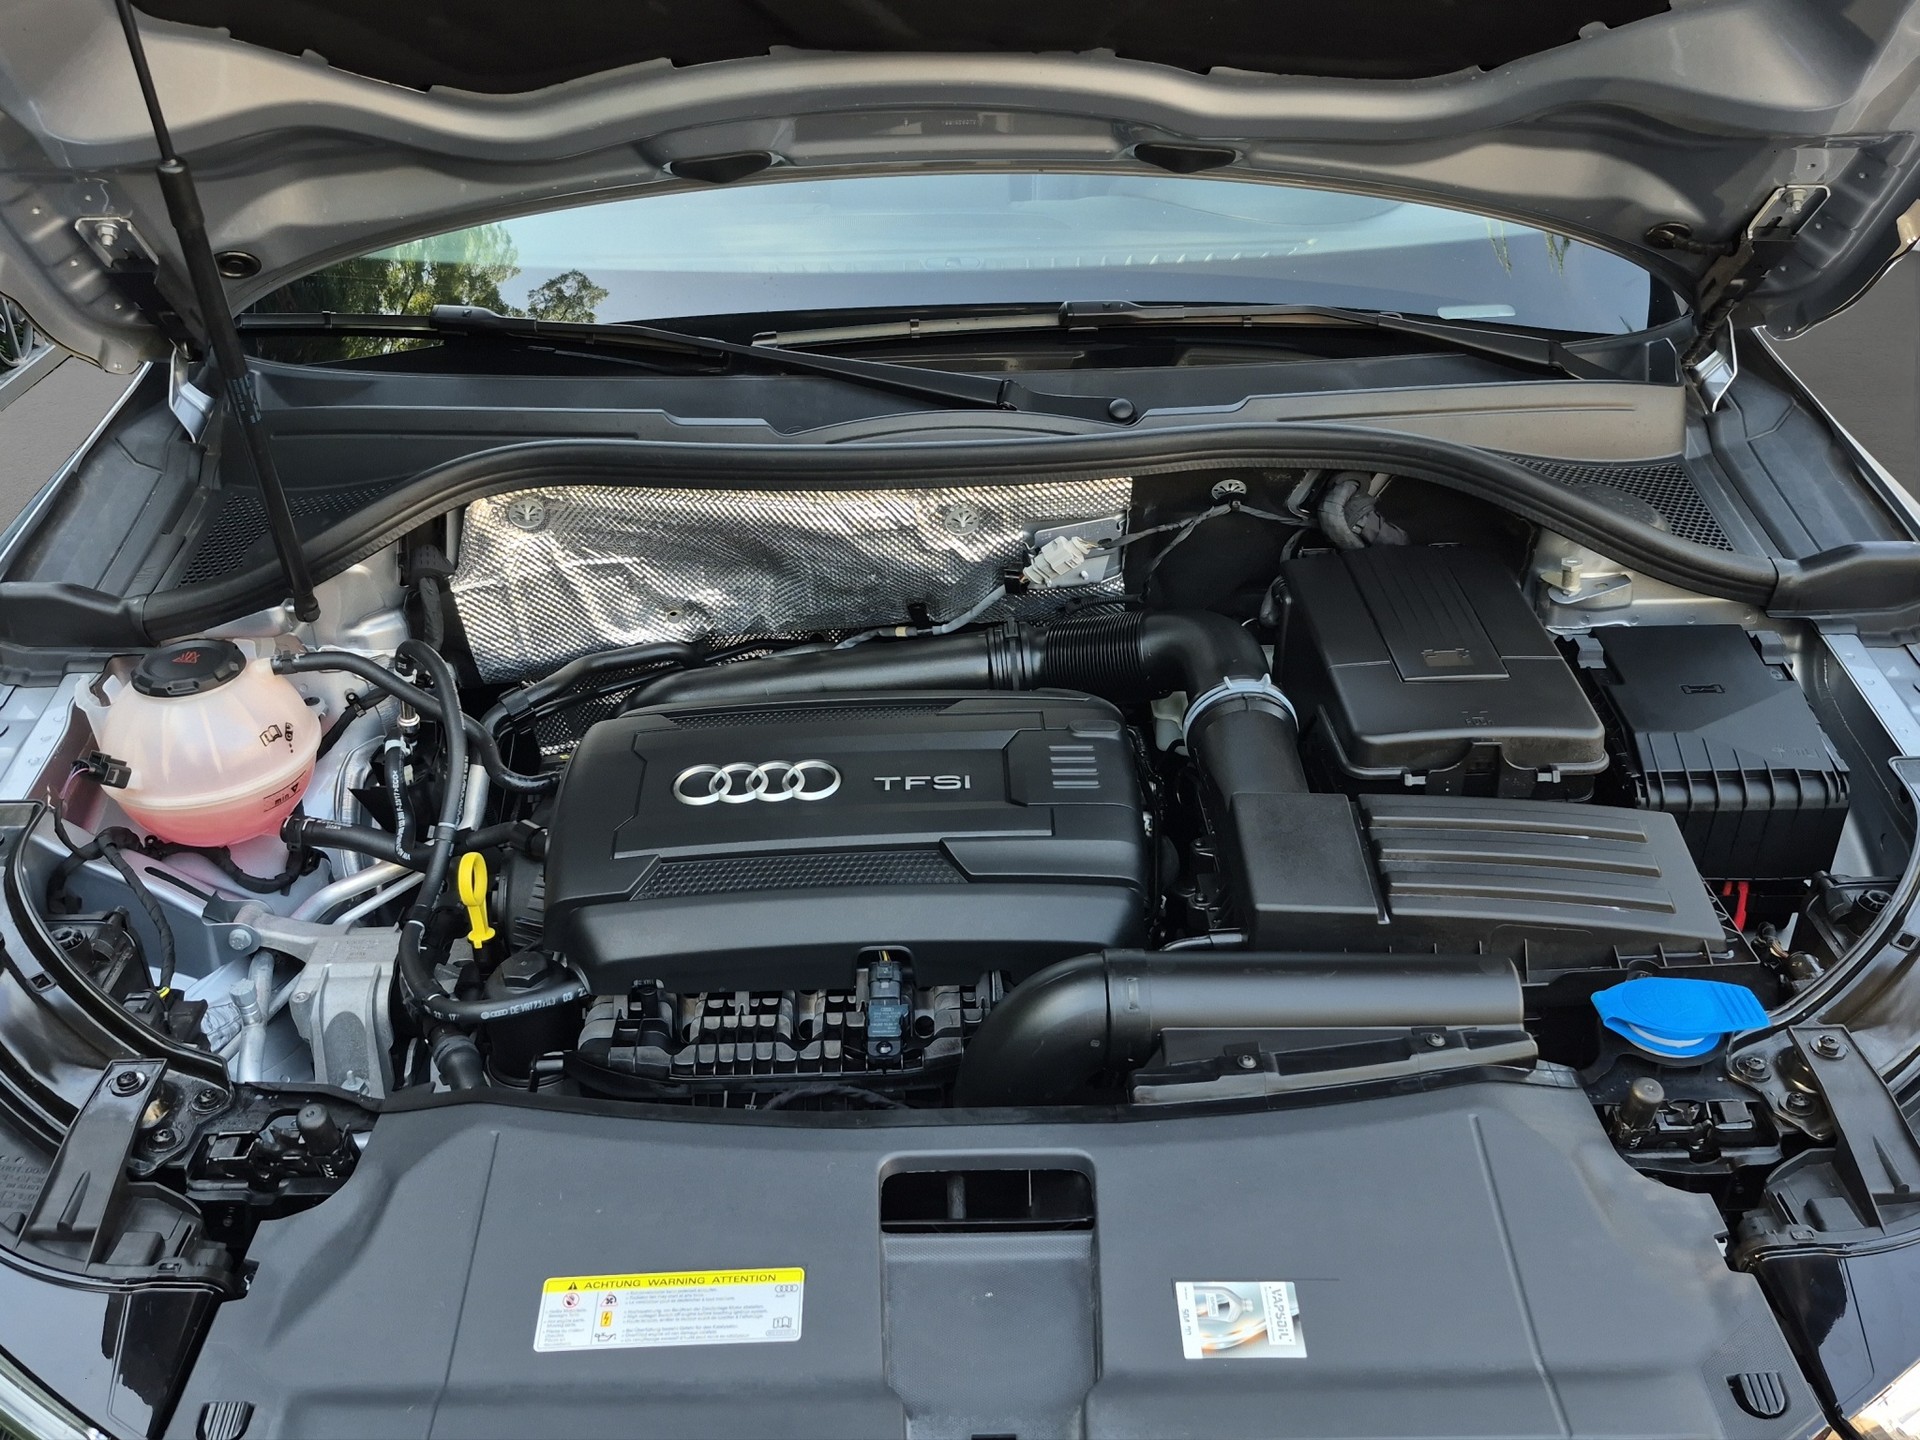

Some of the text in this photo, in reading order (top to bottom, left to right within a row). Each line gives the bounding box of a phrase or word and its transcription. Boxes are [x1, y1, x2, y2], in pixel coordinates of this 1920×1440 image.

[874, 774, 971, 791] TFSI
[275, 793, 290, 806] min
[584, 1274, 777, 1290] ACHTUNG WARNING ATTENTION
